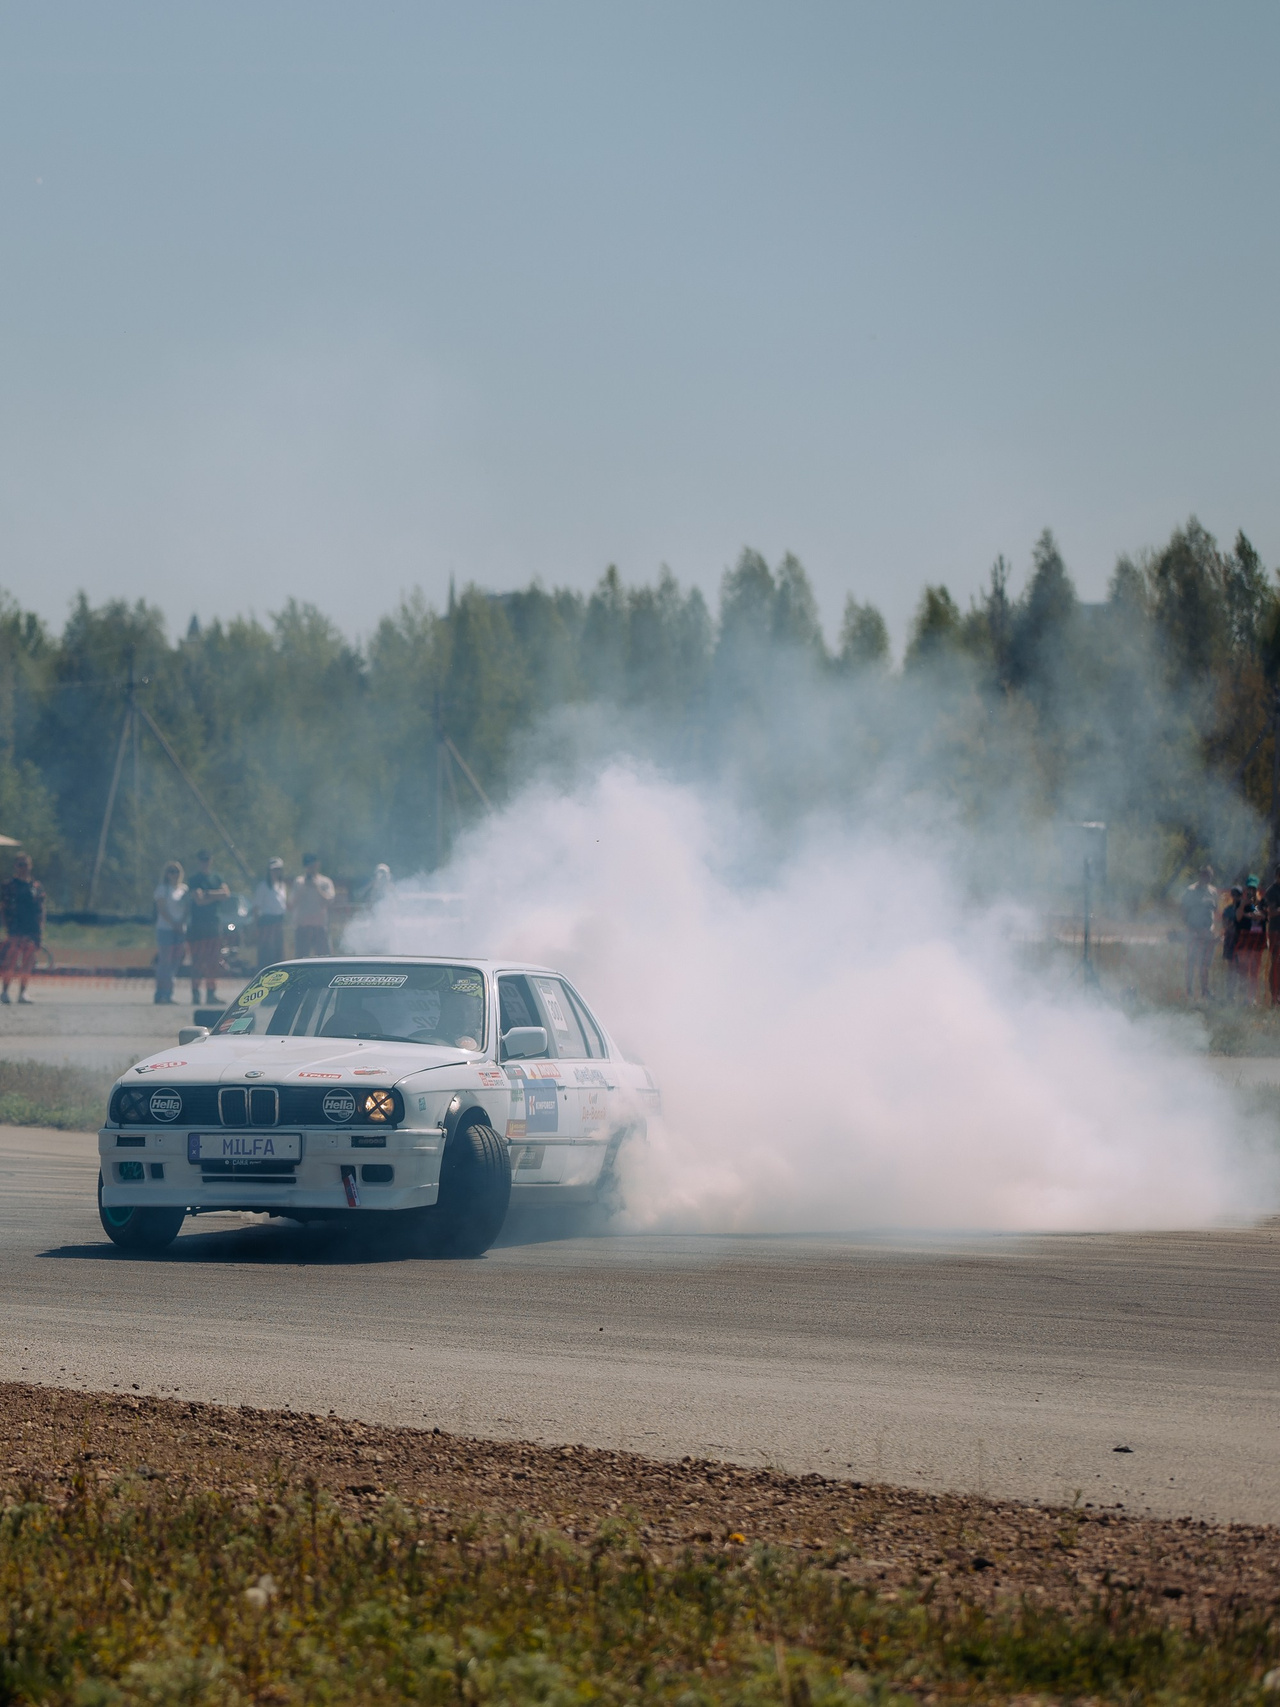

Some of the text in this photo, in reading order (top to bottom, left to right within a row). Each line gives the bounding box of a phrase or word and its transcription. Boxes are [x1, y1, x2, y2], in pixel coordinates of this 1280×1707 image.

[243, 989, 264, 1005] 300
[152, 1100, 180, 1110] Hella
[325, 1100, 353, 1110] Hella
[222, 1138, 275, 1155] MILFA
